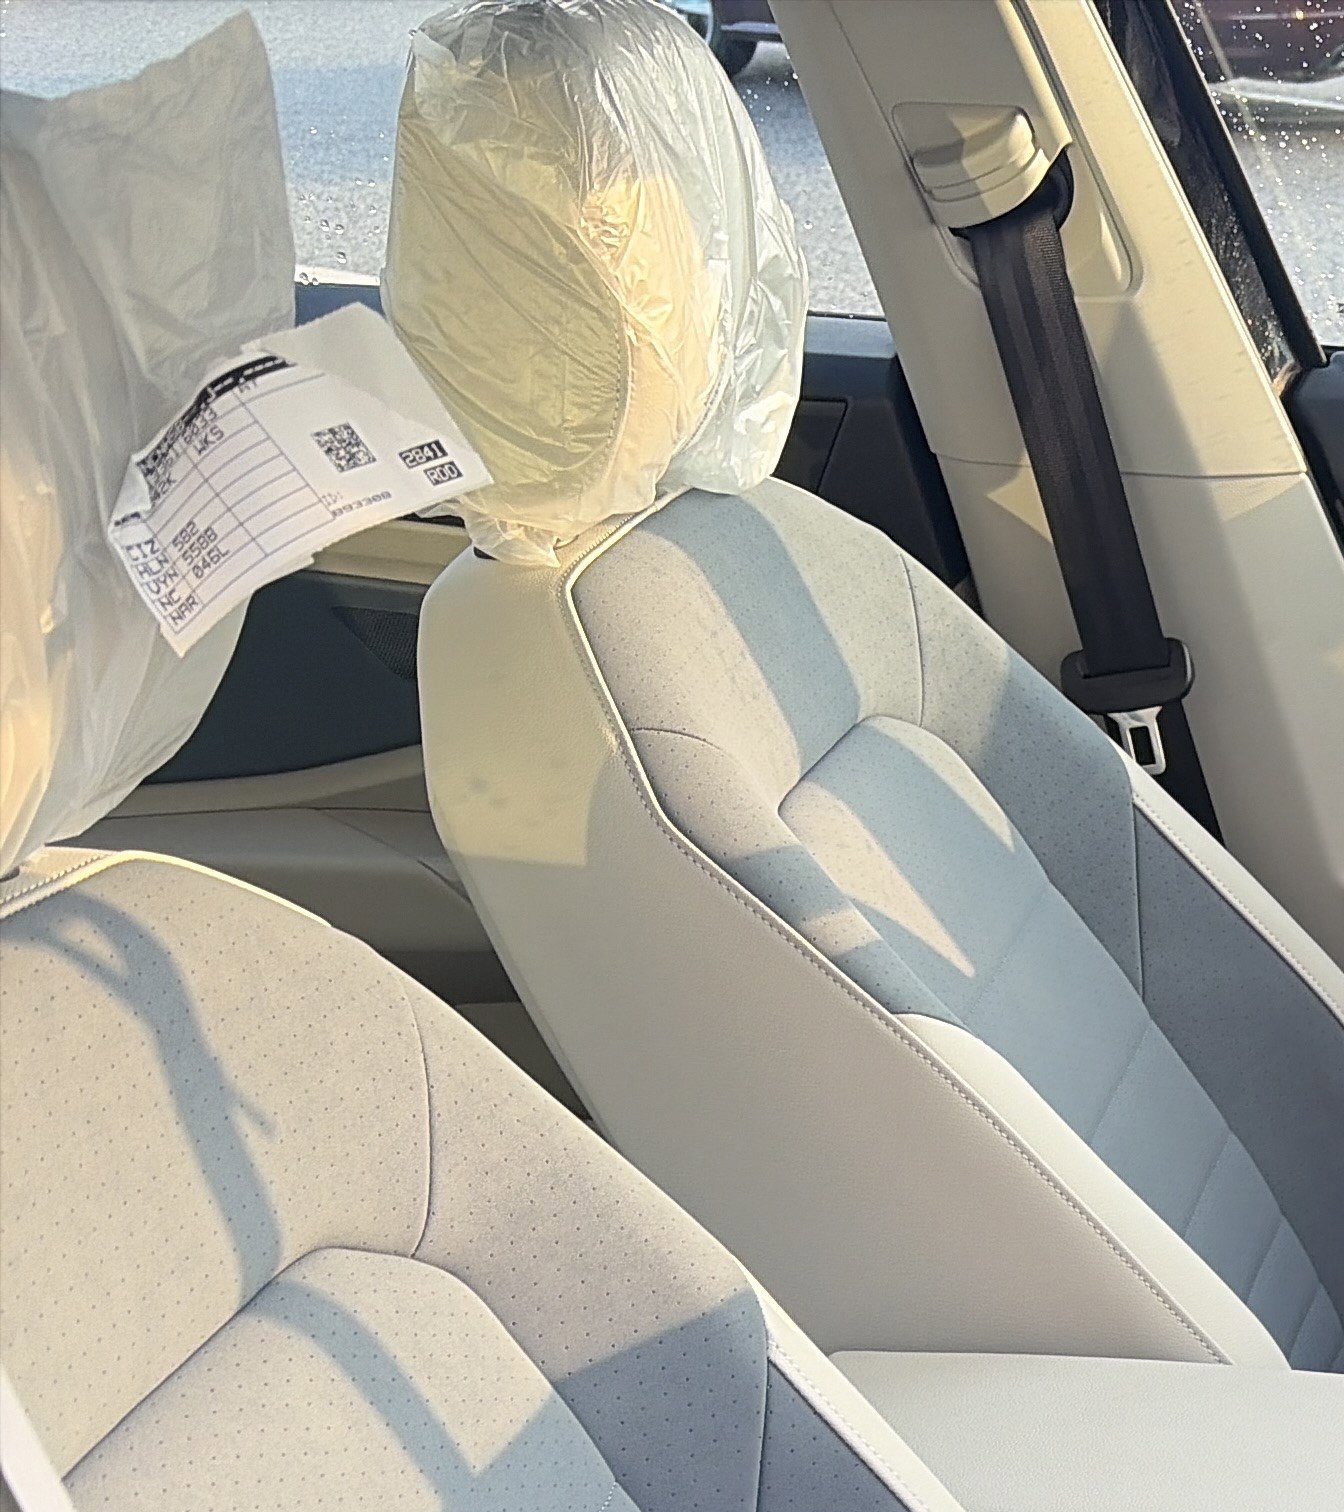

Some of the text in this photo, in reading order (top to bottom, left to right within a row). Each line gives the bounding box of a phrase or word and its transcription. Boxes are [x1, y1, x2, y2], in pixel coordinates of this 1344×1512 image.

[402, 443, 443, 466] 2841
[161, 589, 182, 612] NC
[168, 595, 200, 625] NAR
